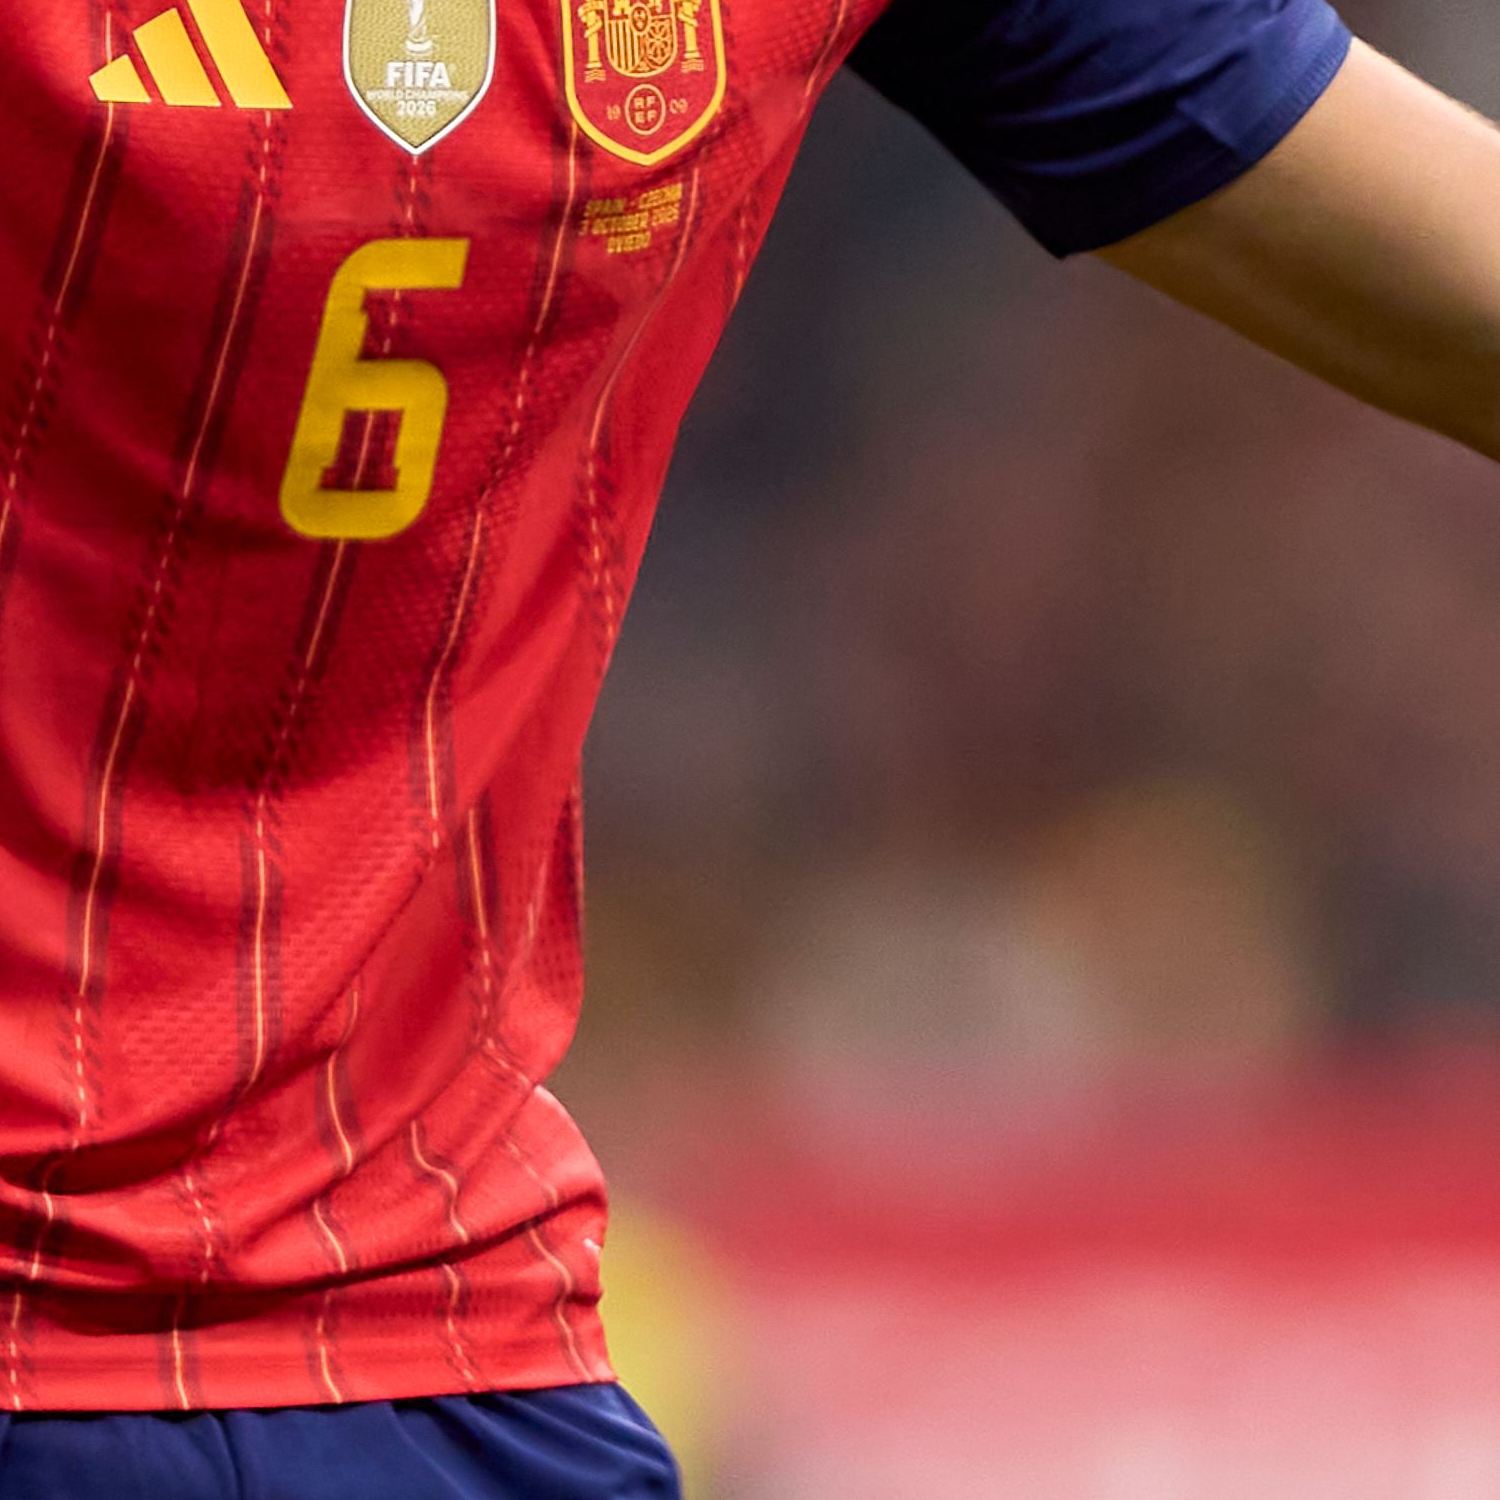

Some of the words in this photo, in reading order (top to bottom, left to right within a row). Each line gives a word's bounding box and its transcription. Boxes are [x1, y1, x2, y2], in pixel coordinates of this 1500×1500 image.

[386, 61, 452, 88] FIFA
[366, 90, 404, 101] WORLD
[633, 96, 656, 109] RF
[396, 100, 437, 116] 2026
[669, 99, 688, 115] 09
[635, 109, 658, 124] EF
[278, 238, 471, 540] 6
